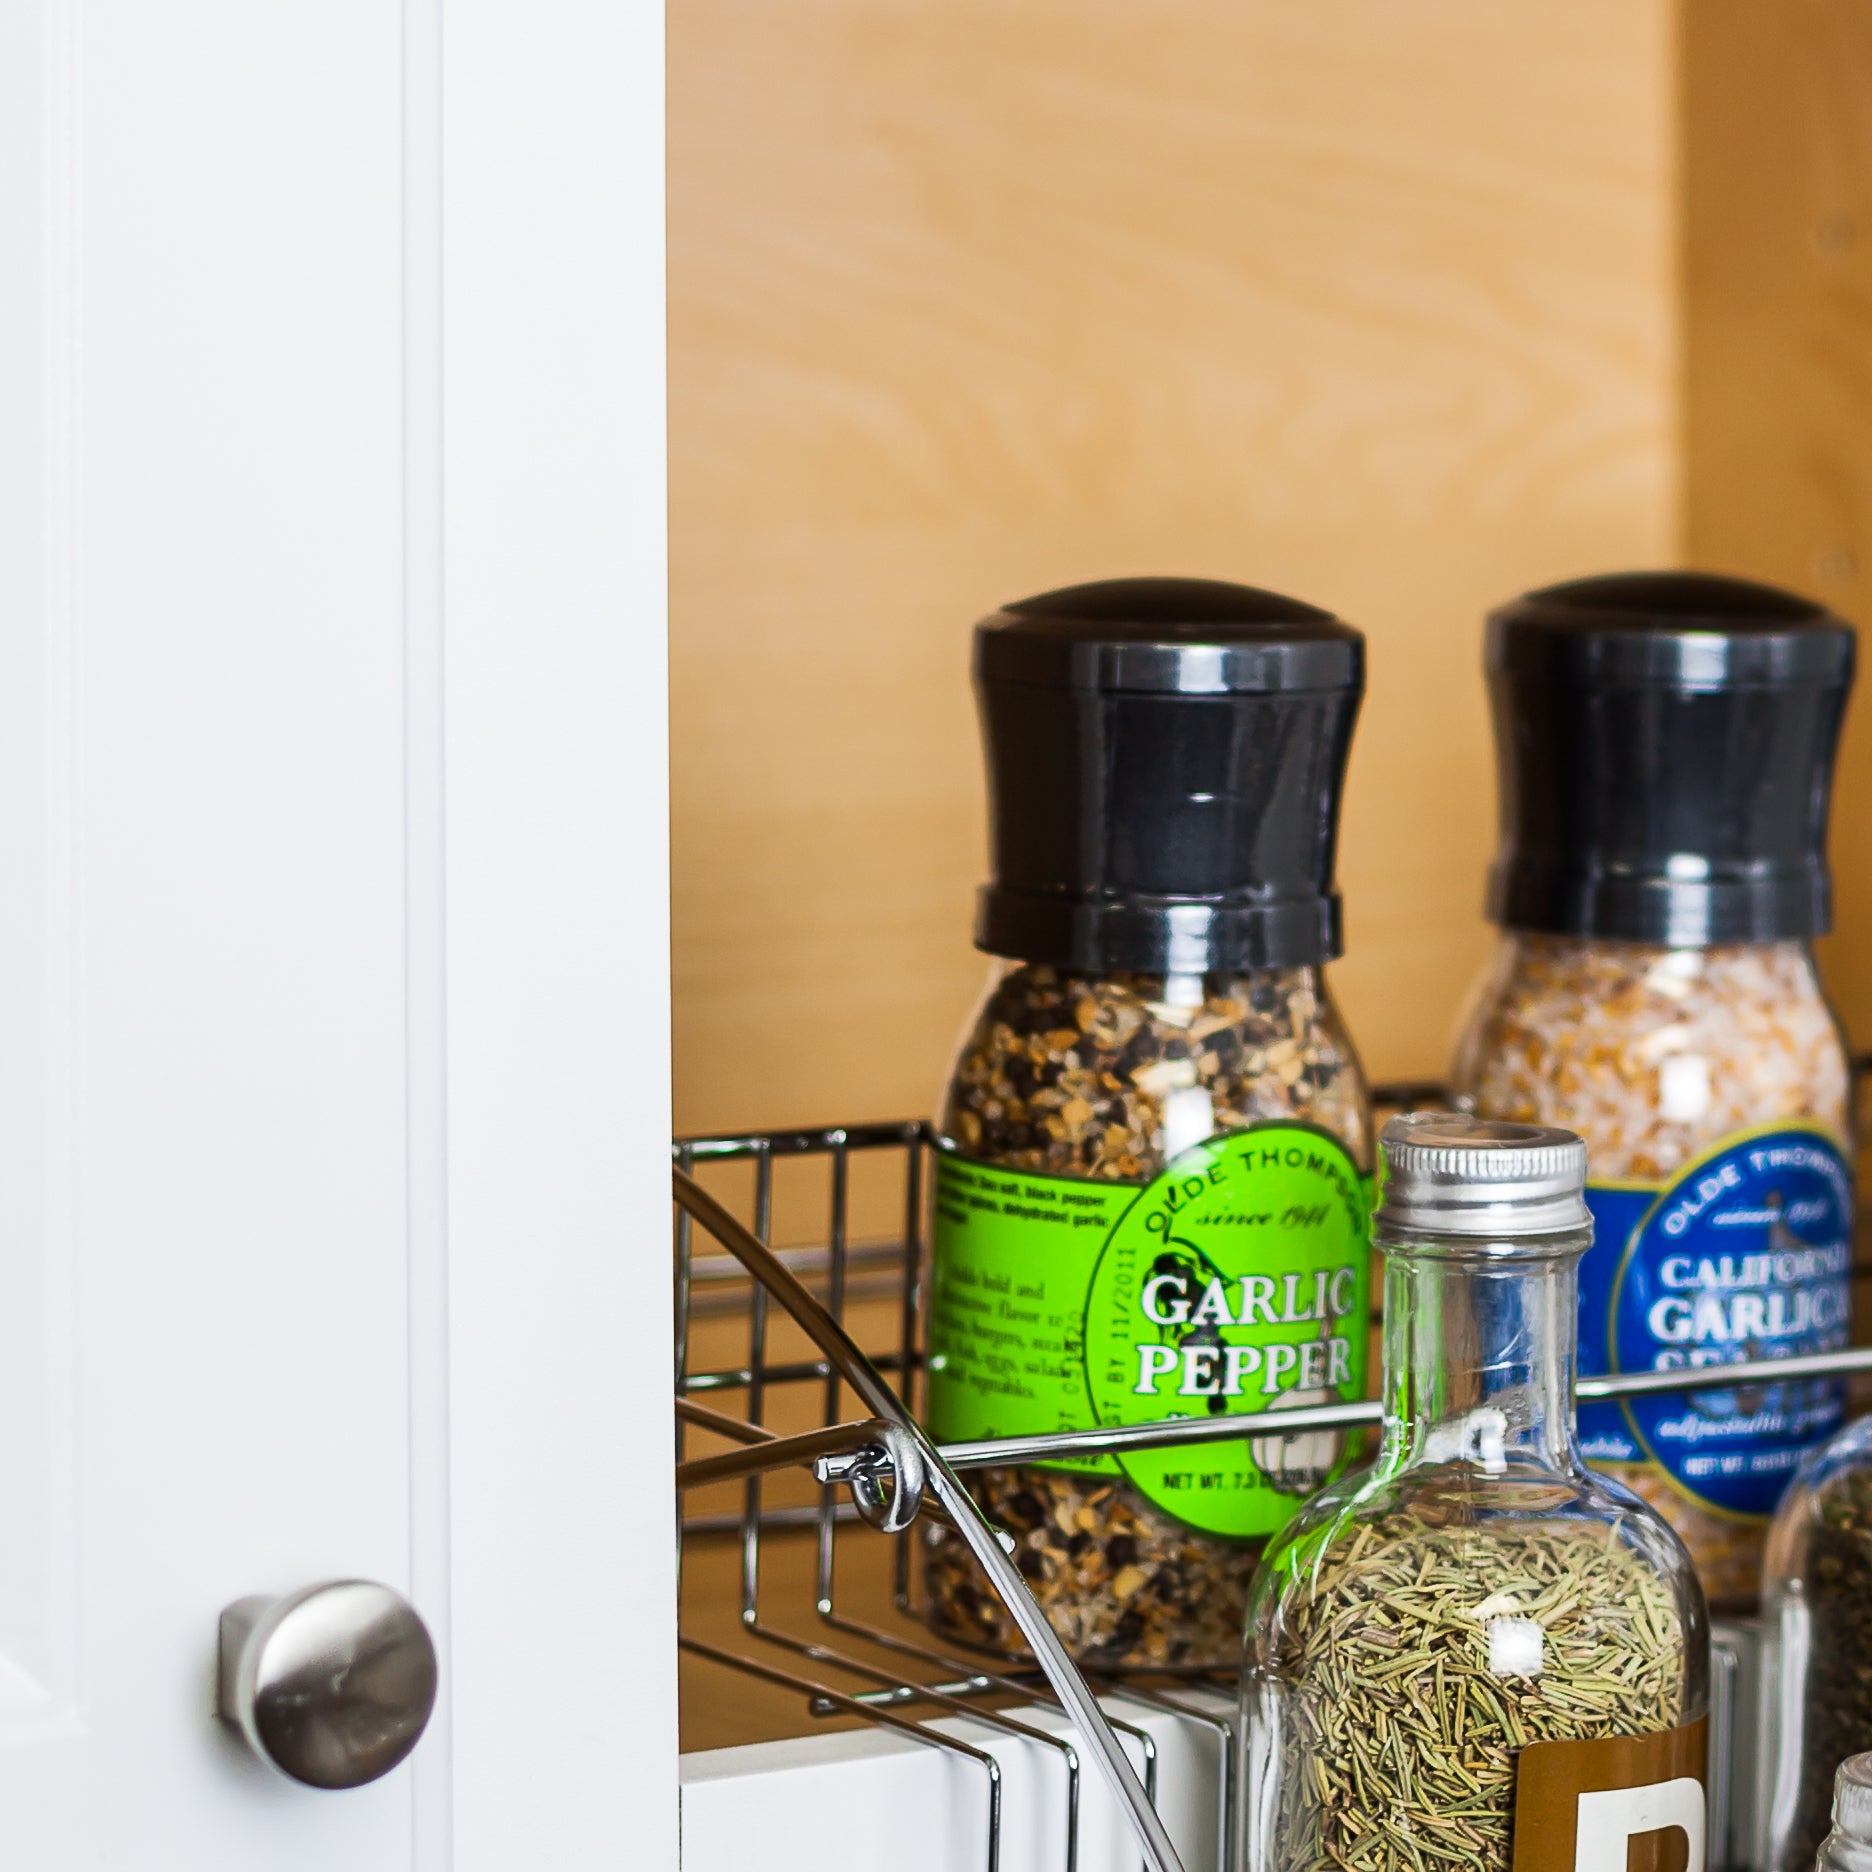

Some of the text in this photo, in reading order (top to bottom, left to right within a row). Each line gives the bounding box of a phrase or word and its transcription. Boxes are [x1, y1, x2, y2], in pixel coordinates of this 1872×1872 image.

[1061, 1193, 1107, 1208] pepper
[1146, 1162, 1228, 1233] OLDE
[1195, 1205, 1273, 1226] since
[1110, 1248, 1136, 1339] 11/2011
[1141, 1267, 1354, 1326] GARLIC
[1648, 1286, 1835, 1343] GARLIC
[1107, 1358, 1126, 1384] BY
[1134, 1338, 1351, 1396] PEPPER
[1163, 1472, 1194, 1490] NET
